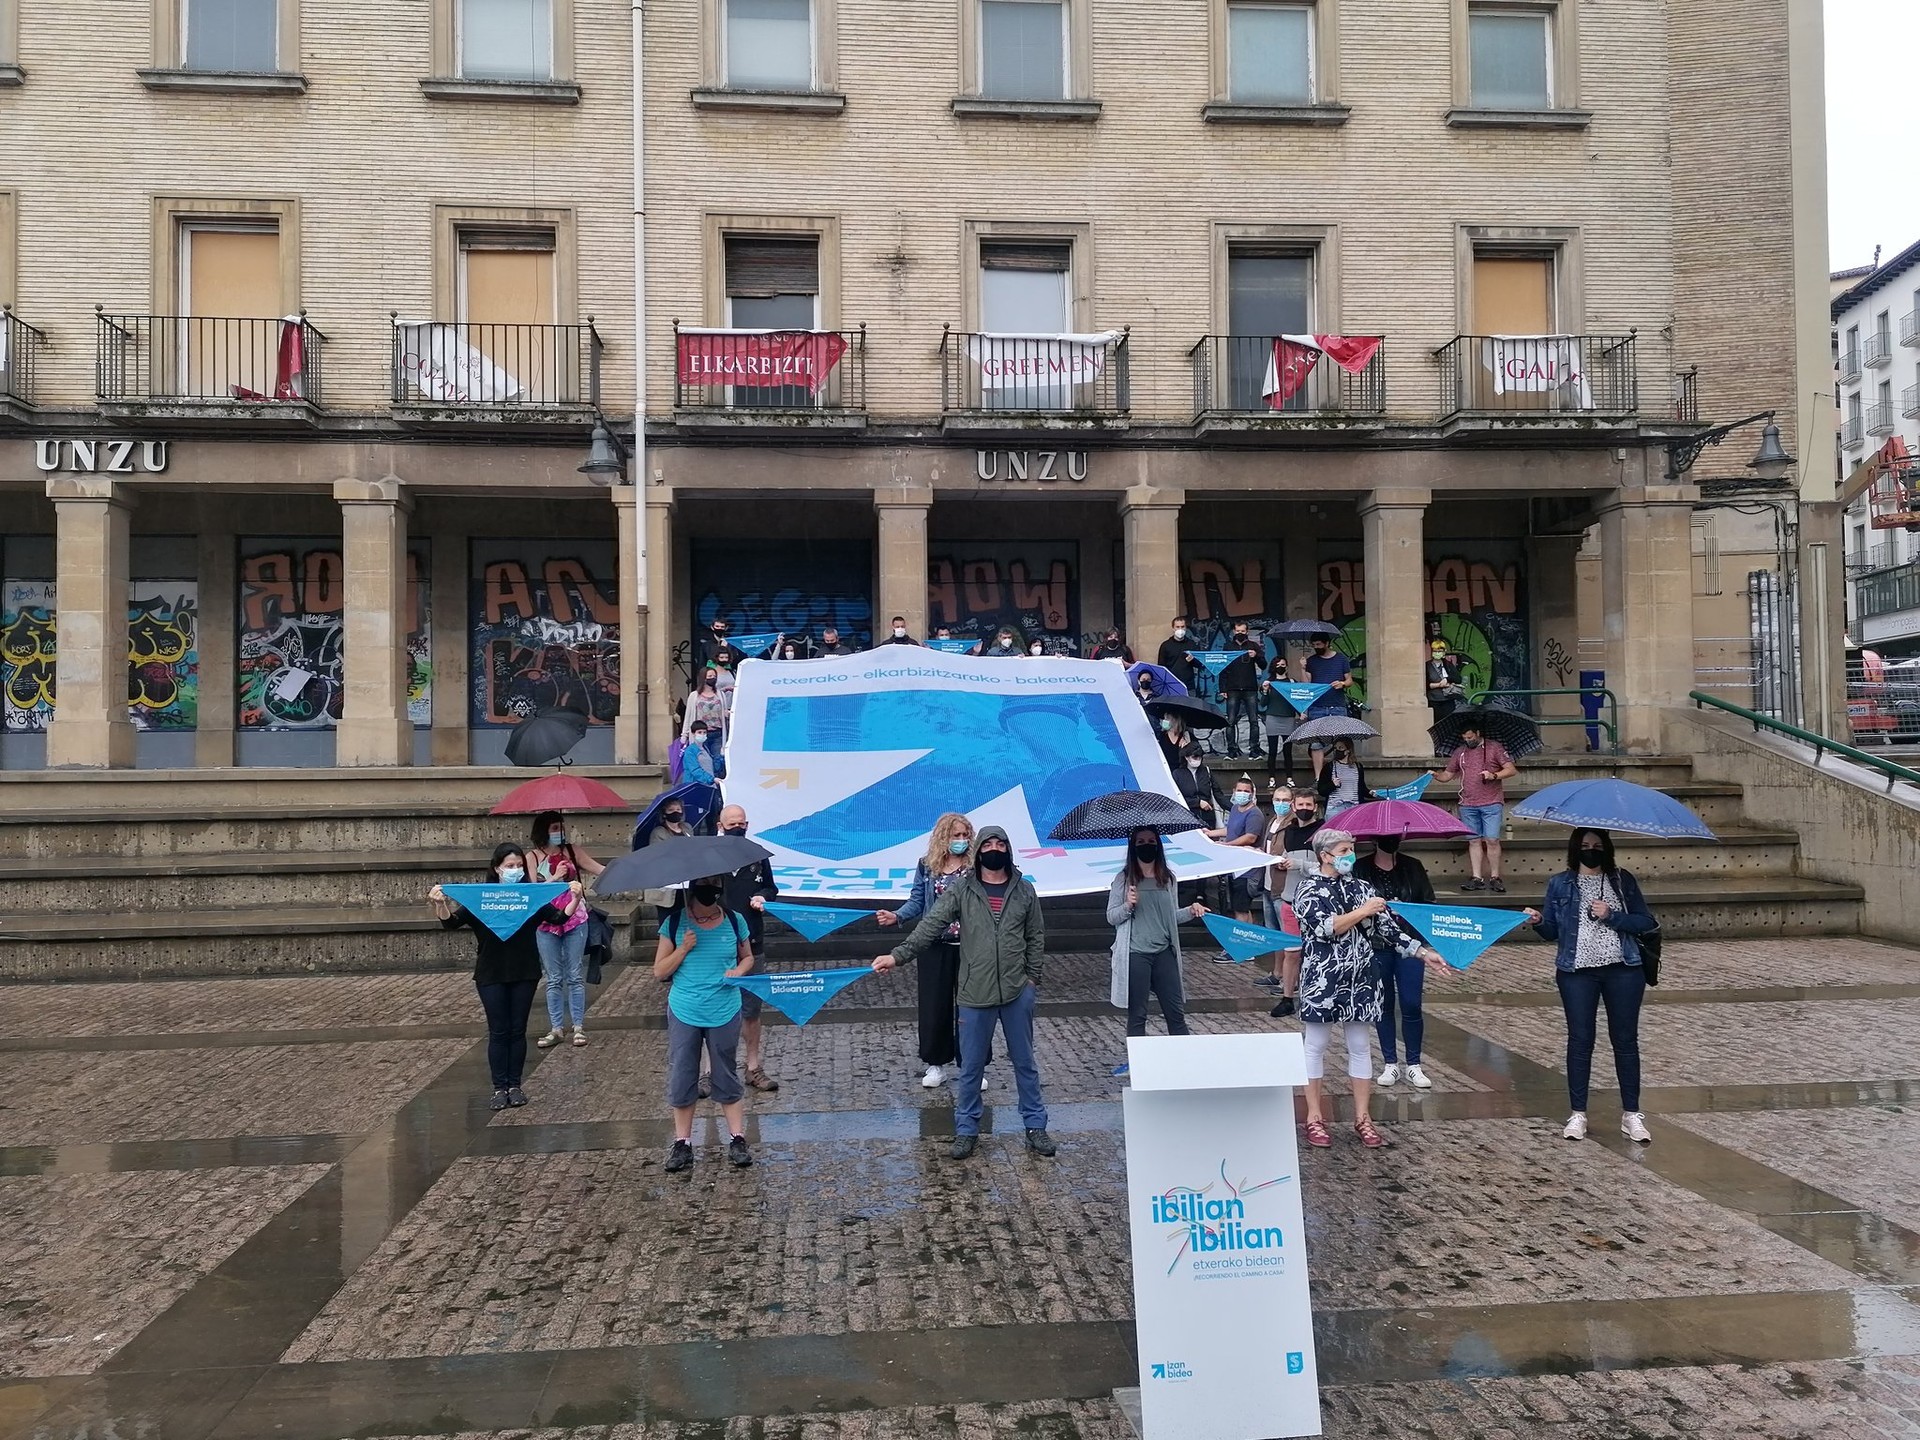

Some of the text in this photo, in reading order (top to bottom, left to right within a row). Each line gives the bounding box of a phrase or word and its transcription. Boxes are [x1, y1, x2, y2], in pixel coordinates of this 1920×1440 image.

[983, 351, 1104, 376] GREEMEN
[35, 440, 168, 472] UNZU
[977, 451, 1088, 480] UNZU
[771, 674, 848, 685] etxerako
[863, 667, 1001, 684] elkarbizitzarako
[1015, 676, 1097, 684] bakerako
[1432, 913, 1473, 925] langileok
[1431, 926, 1460, 938] bidean
[1461, 932, 1482, 940] gara
[771, 985, 802, 994] bidean
[1152, 1193, 1244, 1223] ibilian
[1191, 1222, 1283, 1252] ibilian
[1193, 1255, 1285, 1270] etxerako bidean
[1167, 1361, 1185, 1369] izan
[1168, 1369, 1193, 1378] bidea
